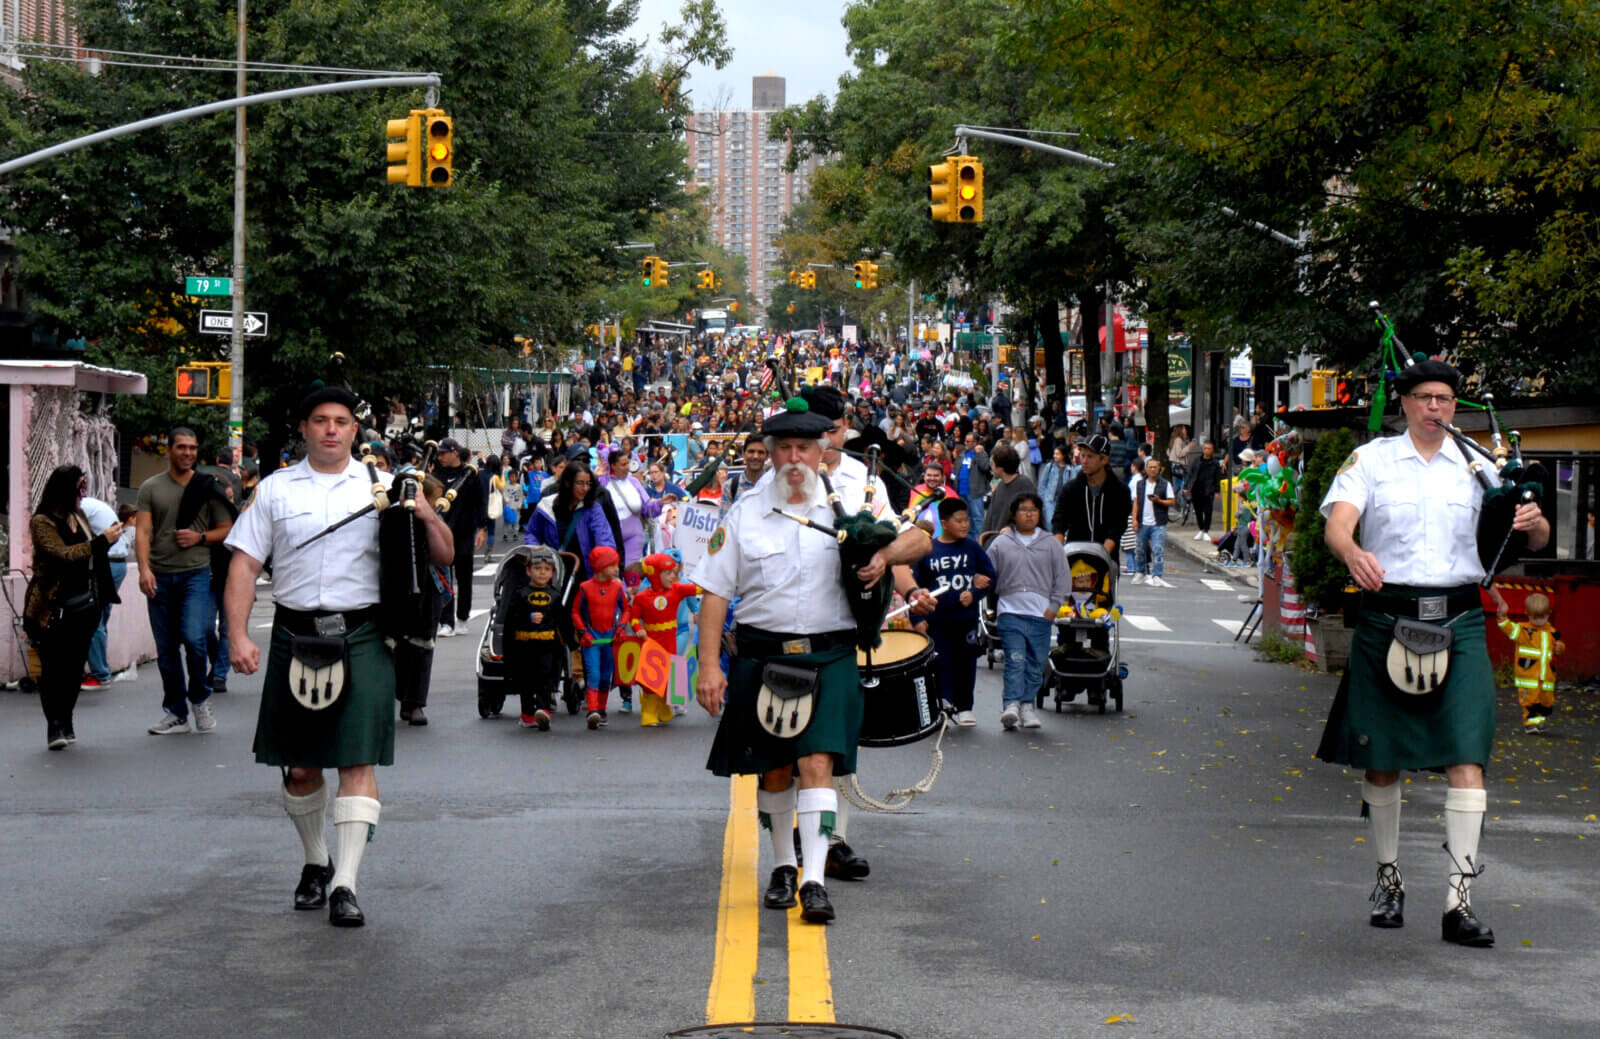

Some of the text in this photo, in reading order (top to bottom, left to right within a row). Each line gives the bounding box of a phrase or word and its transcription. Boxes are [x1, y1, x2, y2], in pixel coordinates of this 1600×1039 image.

[196, 279, 210, 293] 79
[210, 318, 230, 327] ONE
[682, 506, 720, 533] Distr
[930, 554, 968, 572] HEY!
[936, 574, 973, 591] BOY
